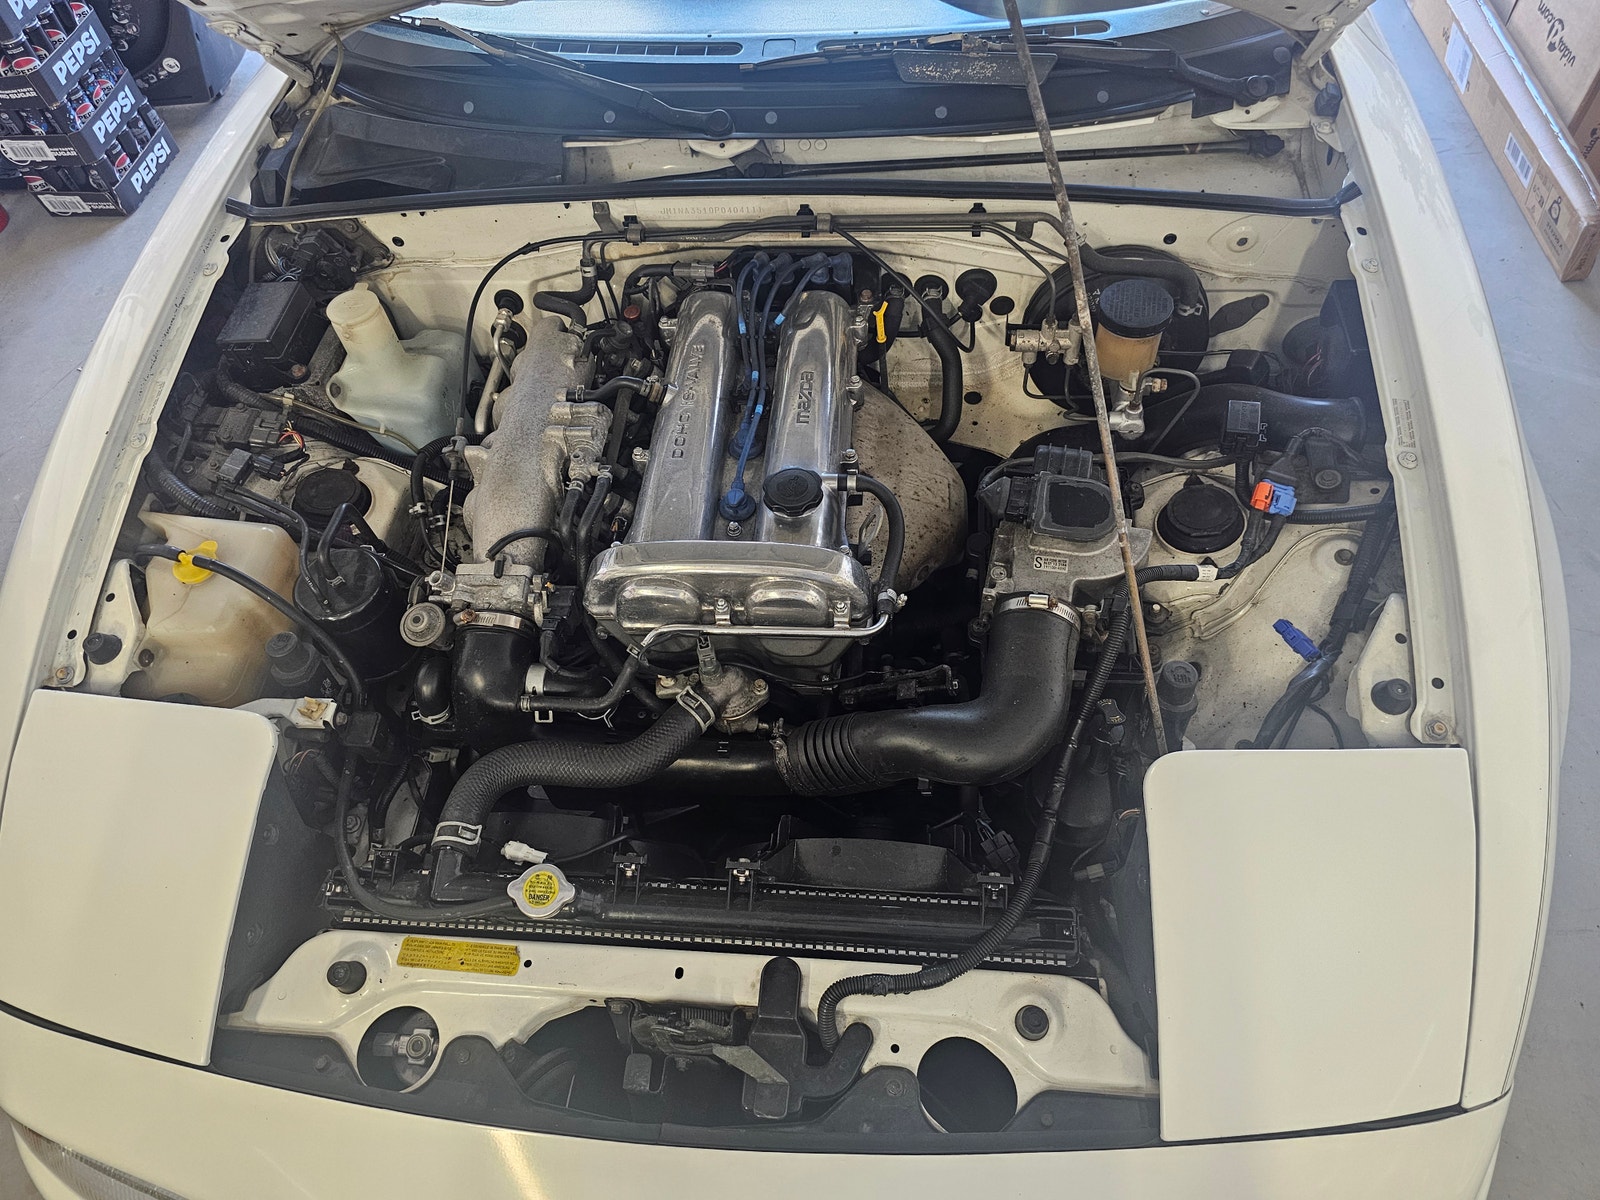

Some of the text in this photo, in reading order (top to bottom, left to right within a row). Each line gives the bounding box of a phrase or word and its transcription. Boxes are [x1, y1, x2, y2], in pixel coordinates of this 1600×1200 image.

[52, 24, 101, 86] PEPSI
[10, 91, 38, 99] SUGAR
[92, 84, 136, 144] PEPSI
[130, 136, 172, 194] PEPSI
[796, 370, 815, 425] mazda
[671, 412, 691, 459] DOHC
[1034, 556, 1043, 569] S
[528, 893, 550, 901] DANGER
